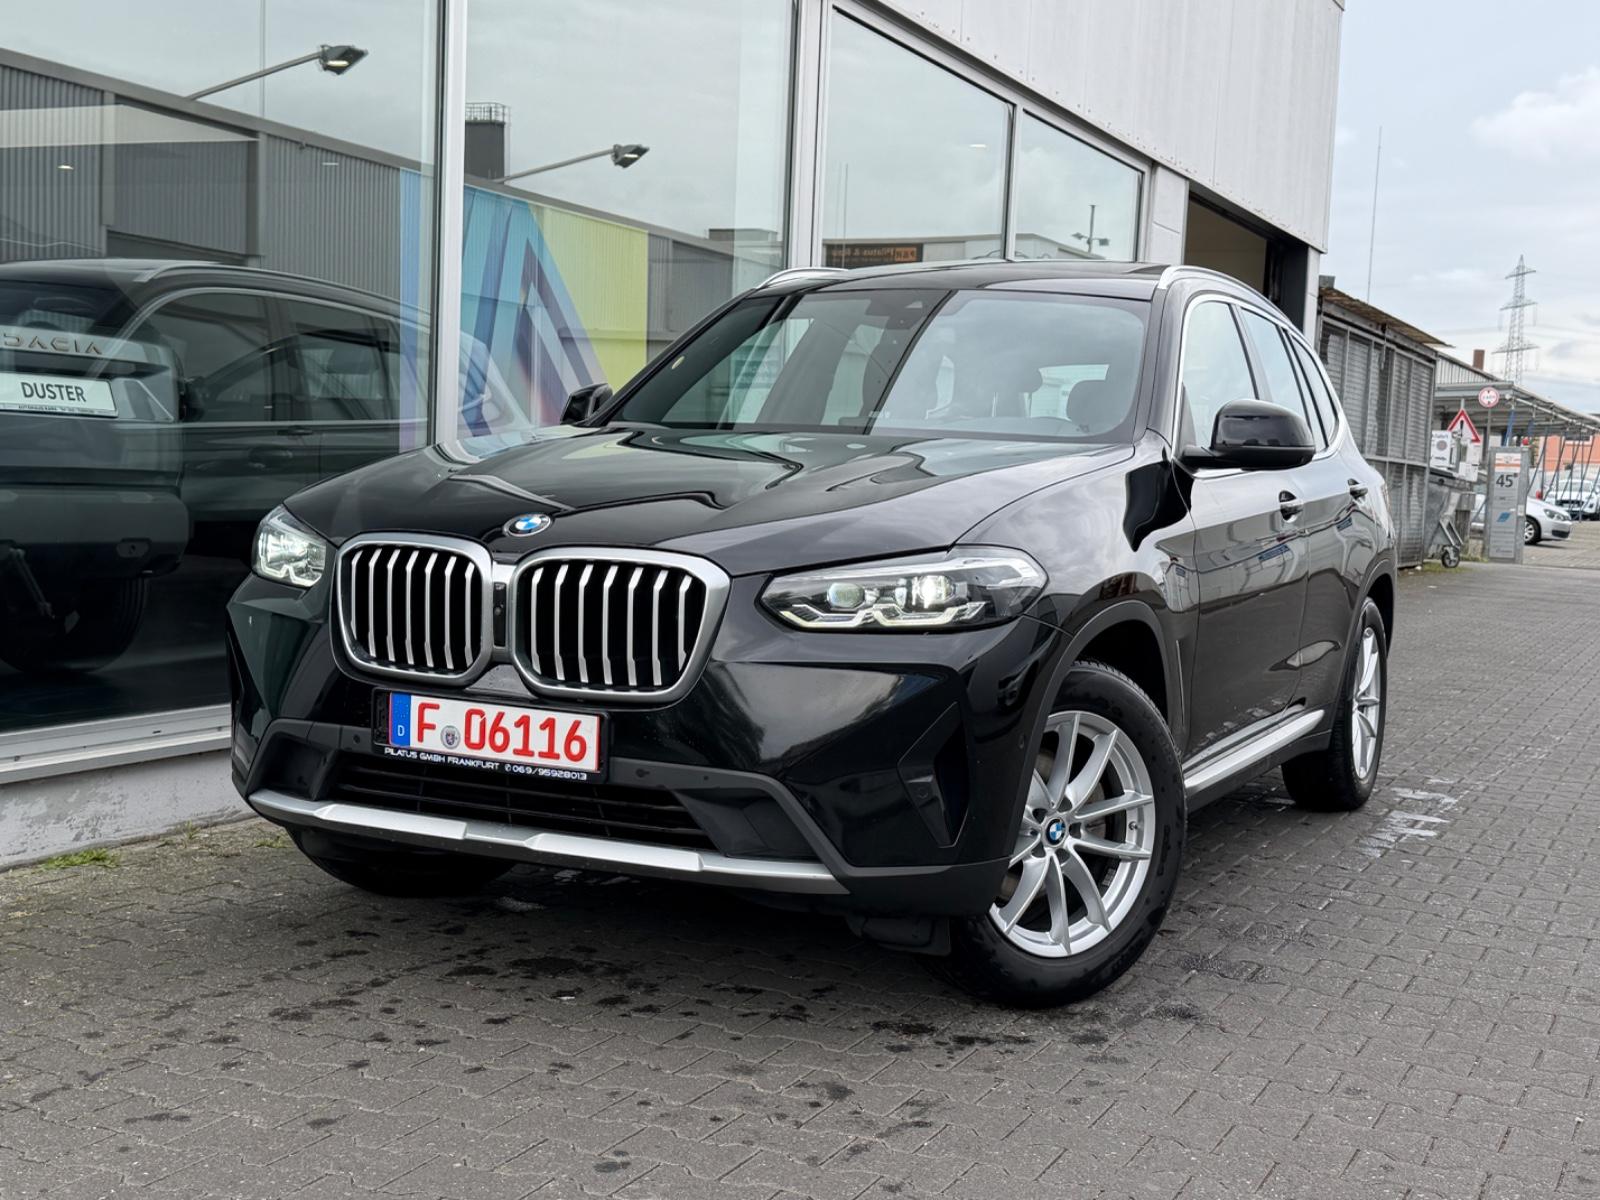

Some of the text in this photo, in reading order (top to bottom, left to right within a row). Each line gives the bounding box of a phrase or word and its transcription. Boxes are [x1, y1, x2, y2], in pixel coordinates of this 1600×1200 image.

[3, 333, 102, 355] DACIA
[21, 382, 86, 402] DUSTER
[397, 725, 405, 737] D
[417, 702, 587, 762] F 06116
[384, 747, 418, 759] PILATUS
[419, 752, 446, 763] GMBH
[447, 756, 500, 770] FRANKFURT
